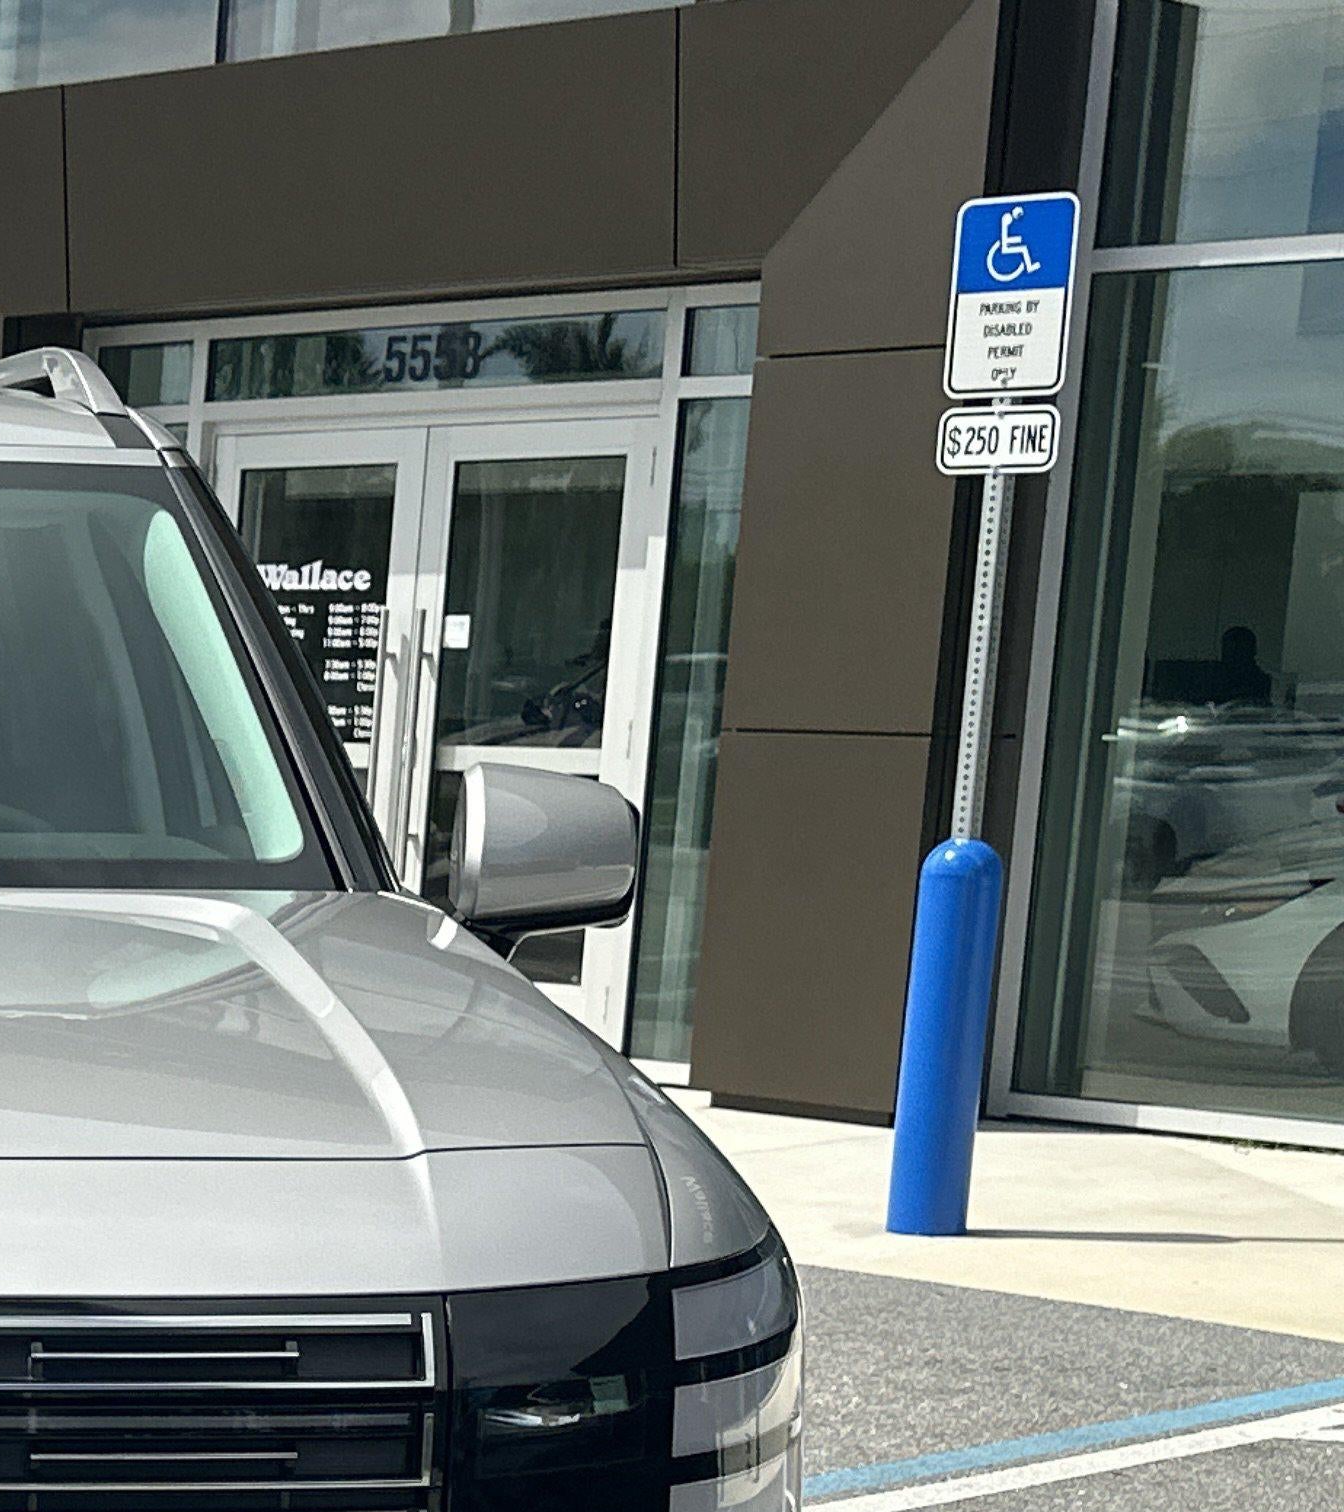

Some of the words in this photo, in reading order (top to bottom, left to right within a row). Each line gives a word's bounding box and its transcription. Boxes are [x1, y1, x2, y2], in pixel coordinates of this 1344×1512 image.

[983, 323, 1033, 338] DISABLED
[987, 345, 1024, 359] PERMIT
[947, 425, 1000, 458] $250
[1009, 424, 1048, 455] FINE
[256, 560, 372, 591] Wallace
